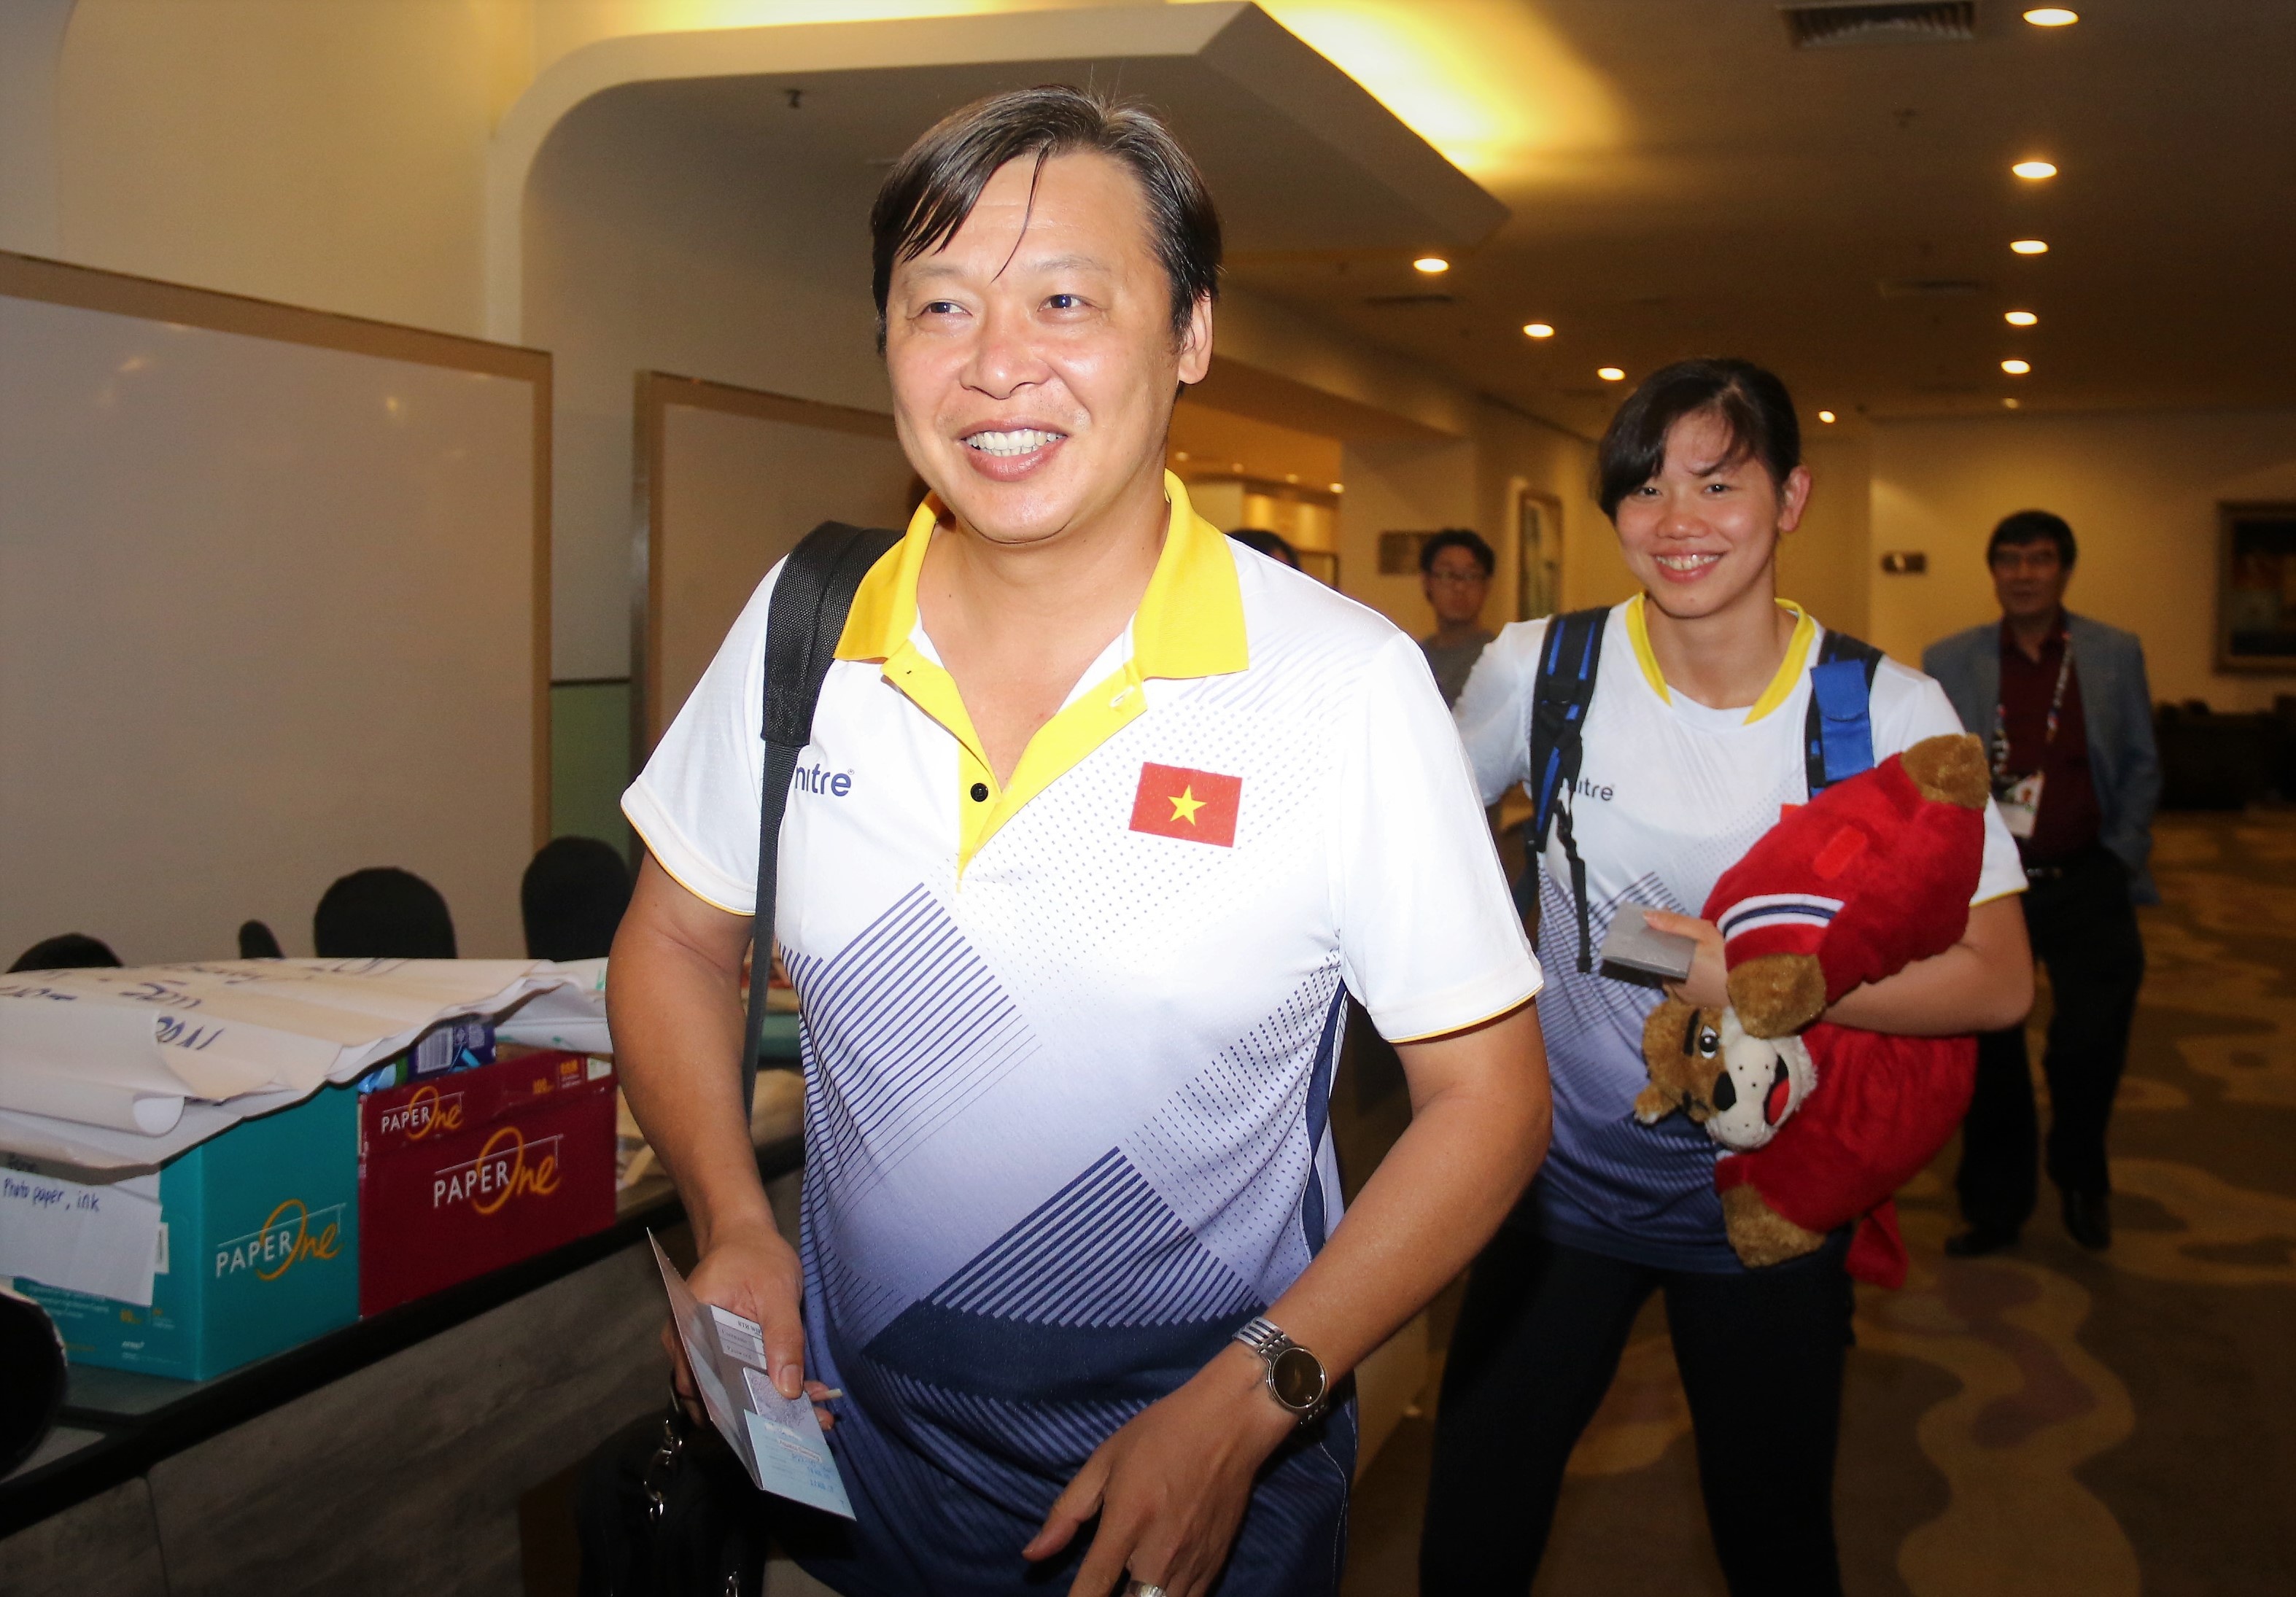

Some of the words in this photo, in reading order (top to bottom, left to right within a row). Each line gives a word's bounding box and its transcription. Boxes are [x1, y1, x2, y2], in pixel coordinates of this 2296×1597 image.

[1578, 777, 1613, 801] itre
[77, 1190, 100, 1212] ink
[433, 1160, 511, 1208] PAPER
[216, 1229, 292, 1278] PAPER
